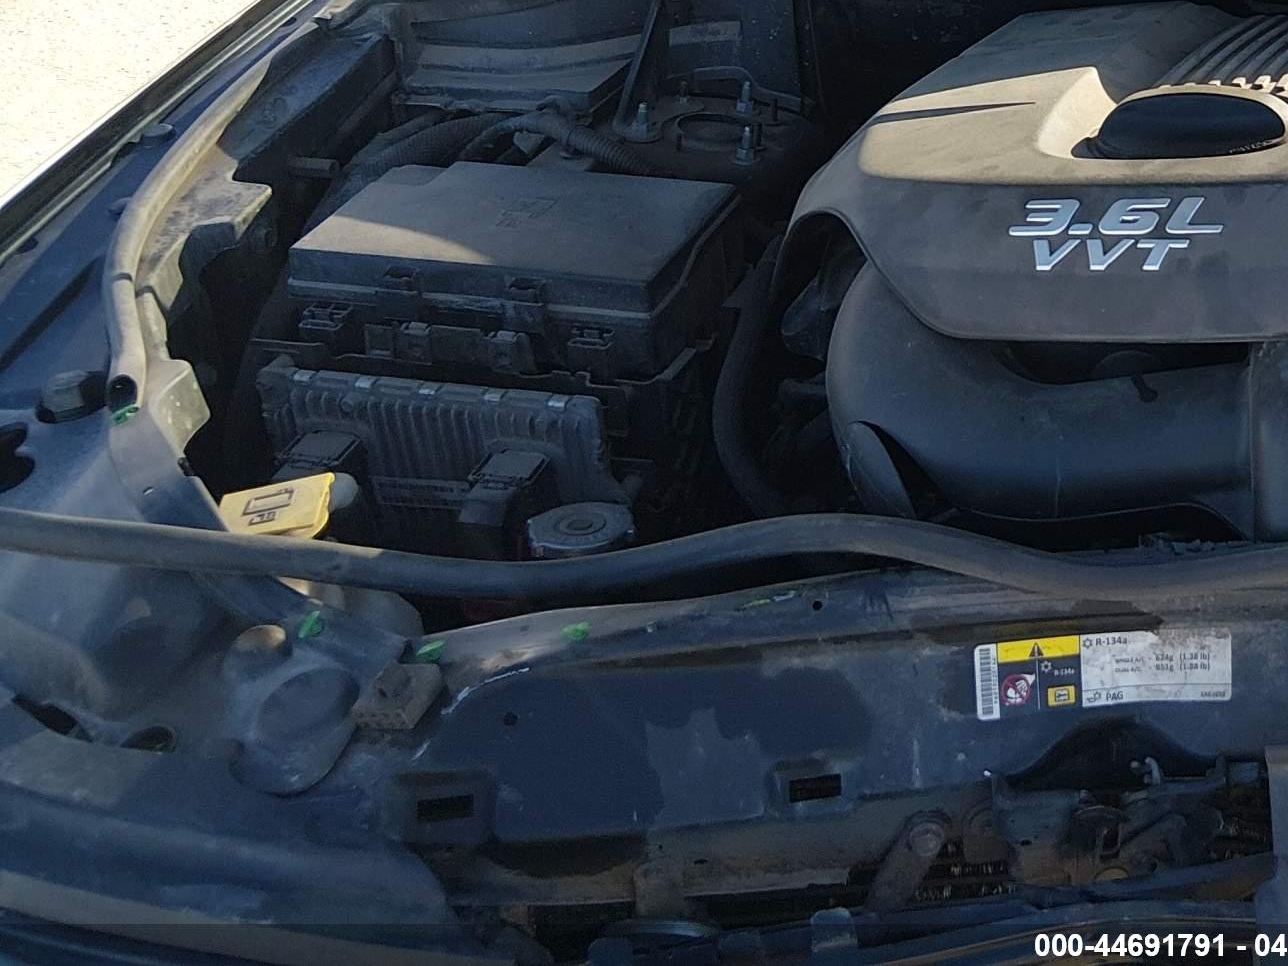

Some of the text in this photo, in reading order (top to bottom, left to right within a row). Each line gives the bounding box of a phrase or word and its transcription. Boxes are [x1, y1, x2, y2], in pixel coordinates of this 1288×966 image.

[1008, 196, 1224, 236] 3.6L
[1033, 238, 1190, 271] VVT
[1095, 636, 1128, 646] R-134a
[1106, 690, 1124, 702] PAG
